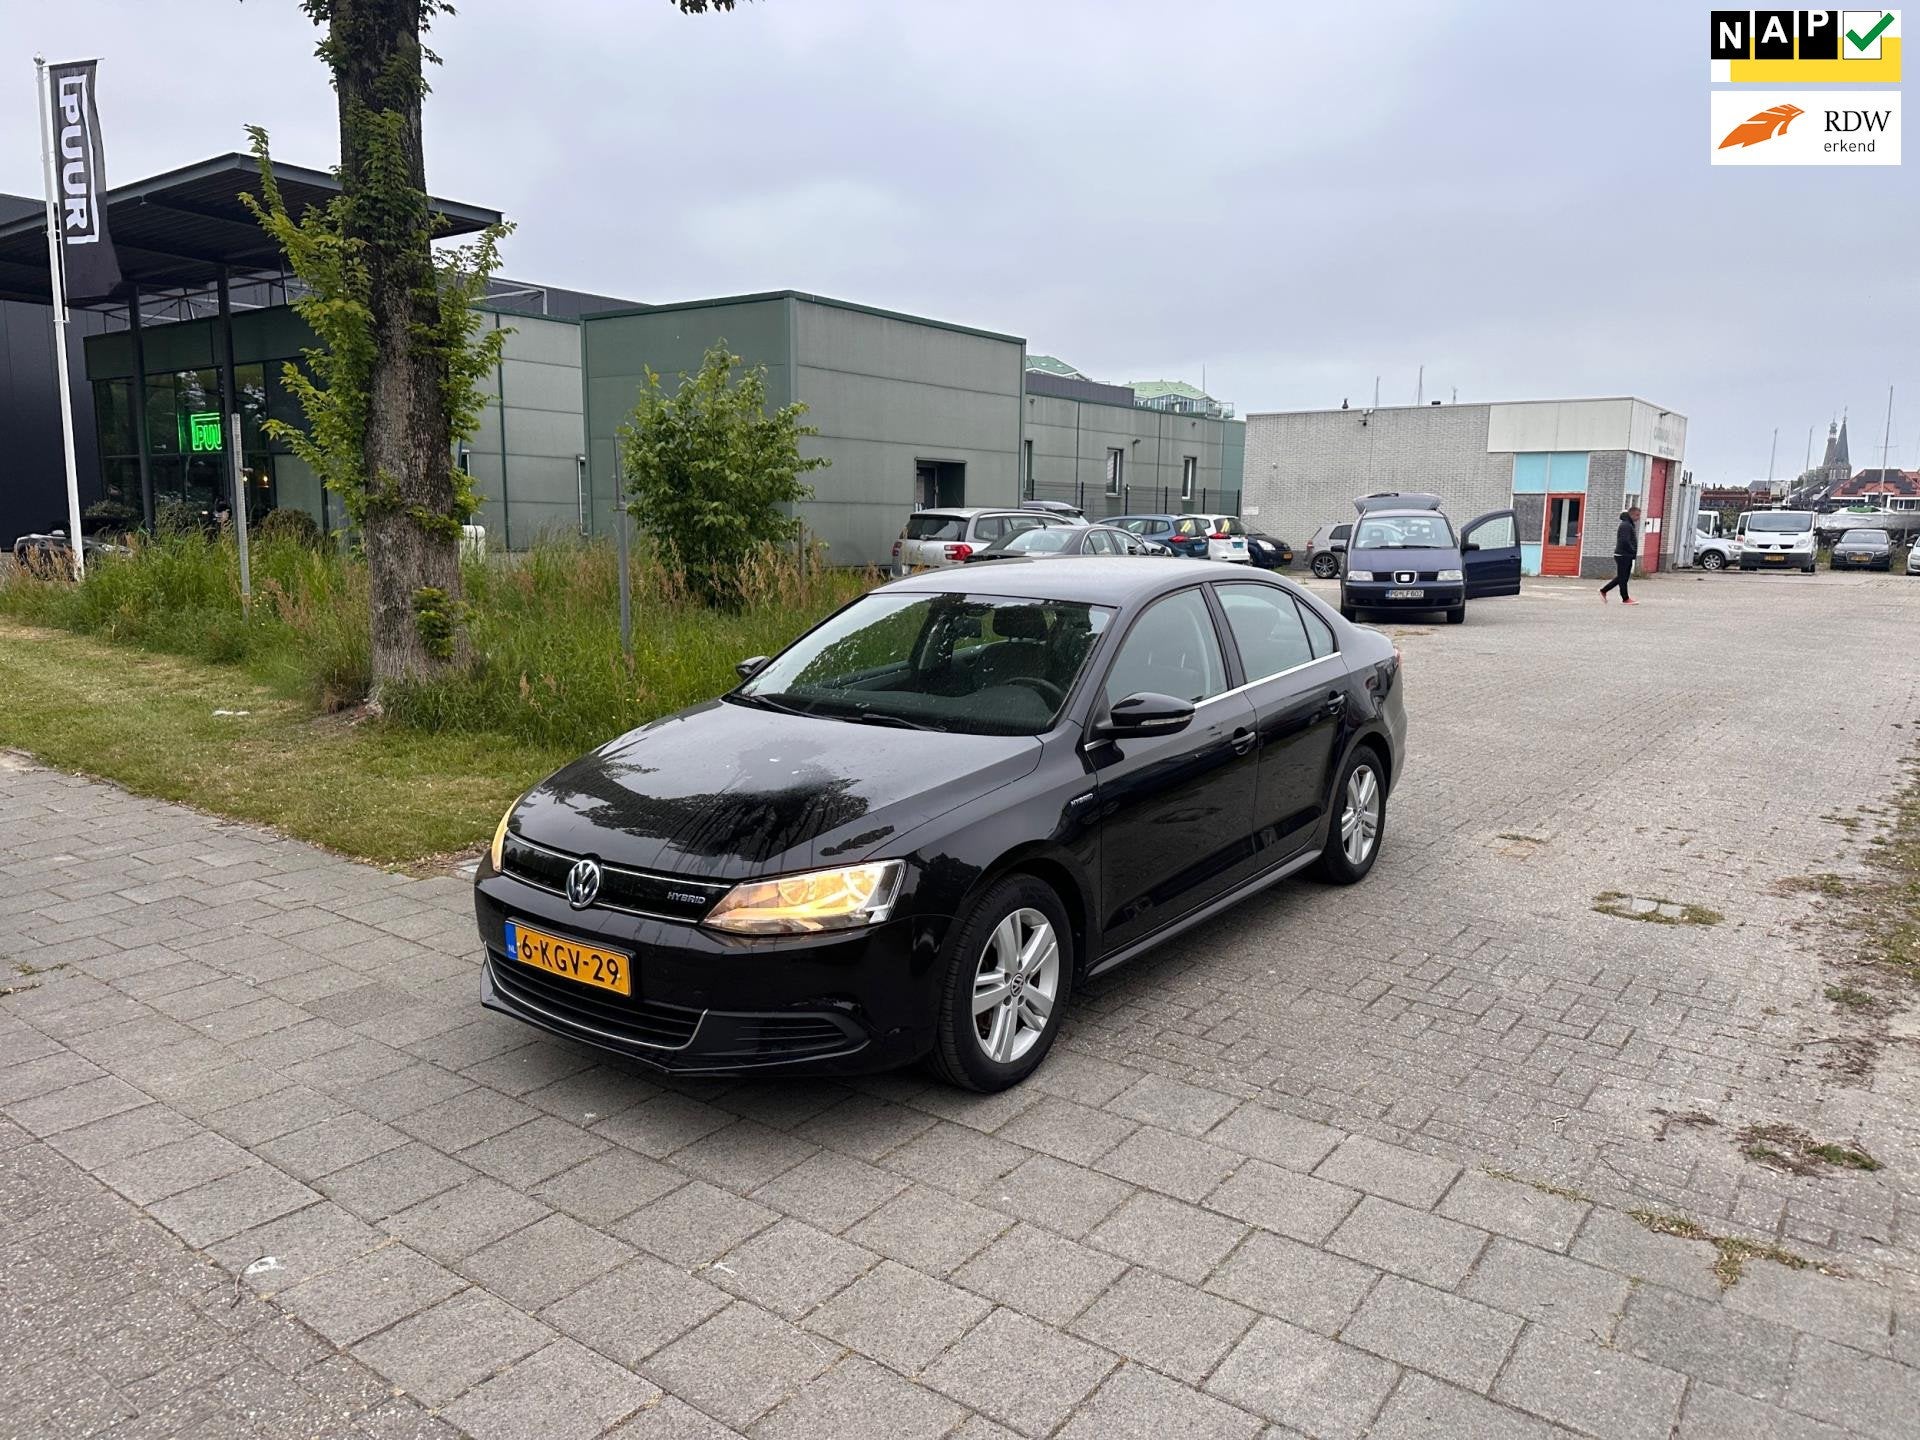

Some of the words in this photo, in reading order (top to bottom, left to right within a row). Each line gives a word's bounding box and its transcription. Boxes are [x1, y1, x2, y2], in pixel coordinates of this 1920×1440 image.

[59, 93, 89, 231] PUUR
[194, 424, 223, 451] PUU
[666, 891, 706, 905] HYBRID
[521, 934, 620, 985] 6-KGV-29
